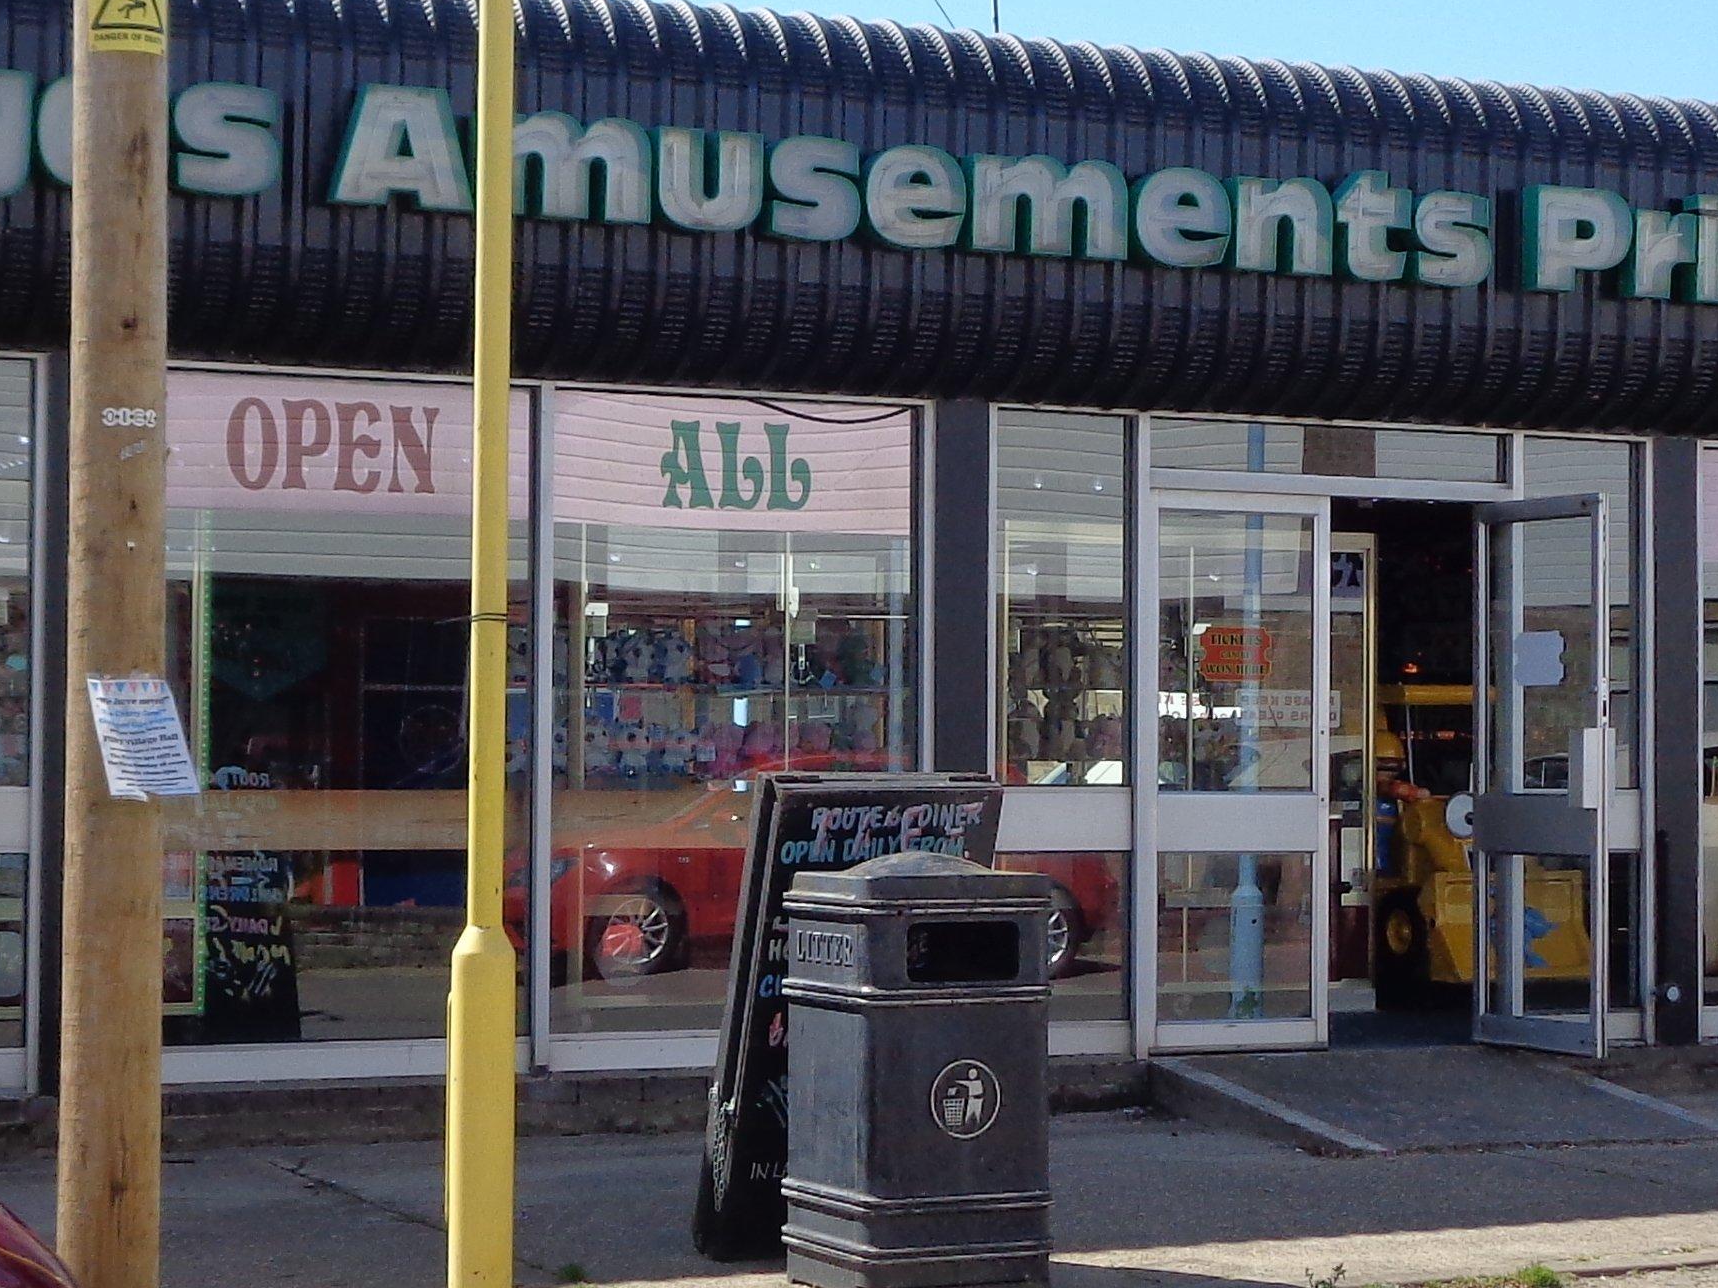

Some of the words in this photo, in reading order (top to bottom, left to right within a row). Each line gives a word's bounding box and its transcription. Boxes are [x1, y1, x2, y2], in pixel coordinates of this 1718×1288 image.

[327, 82, 1495, 288] Amusements
[226, 396, 440, 494] OPEN
[660, 419, 811, 511] ALL
[811, 805, 884, 831] ROUTE
[780, 839, 836, 864] OPEN
[796, 929, 854, 967] LITTER
